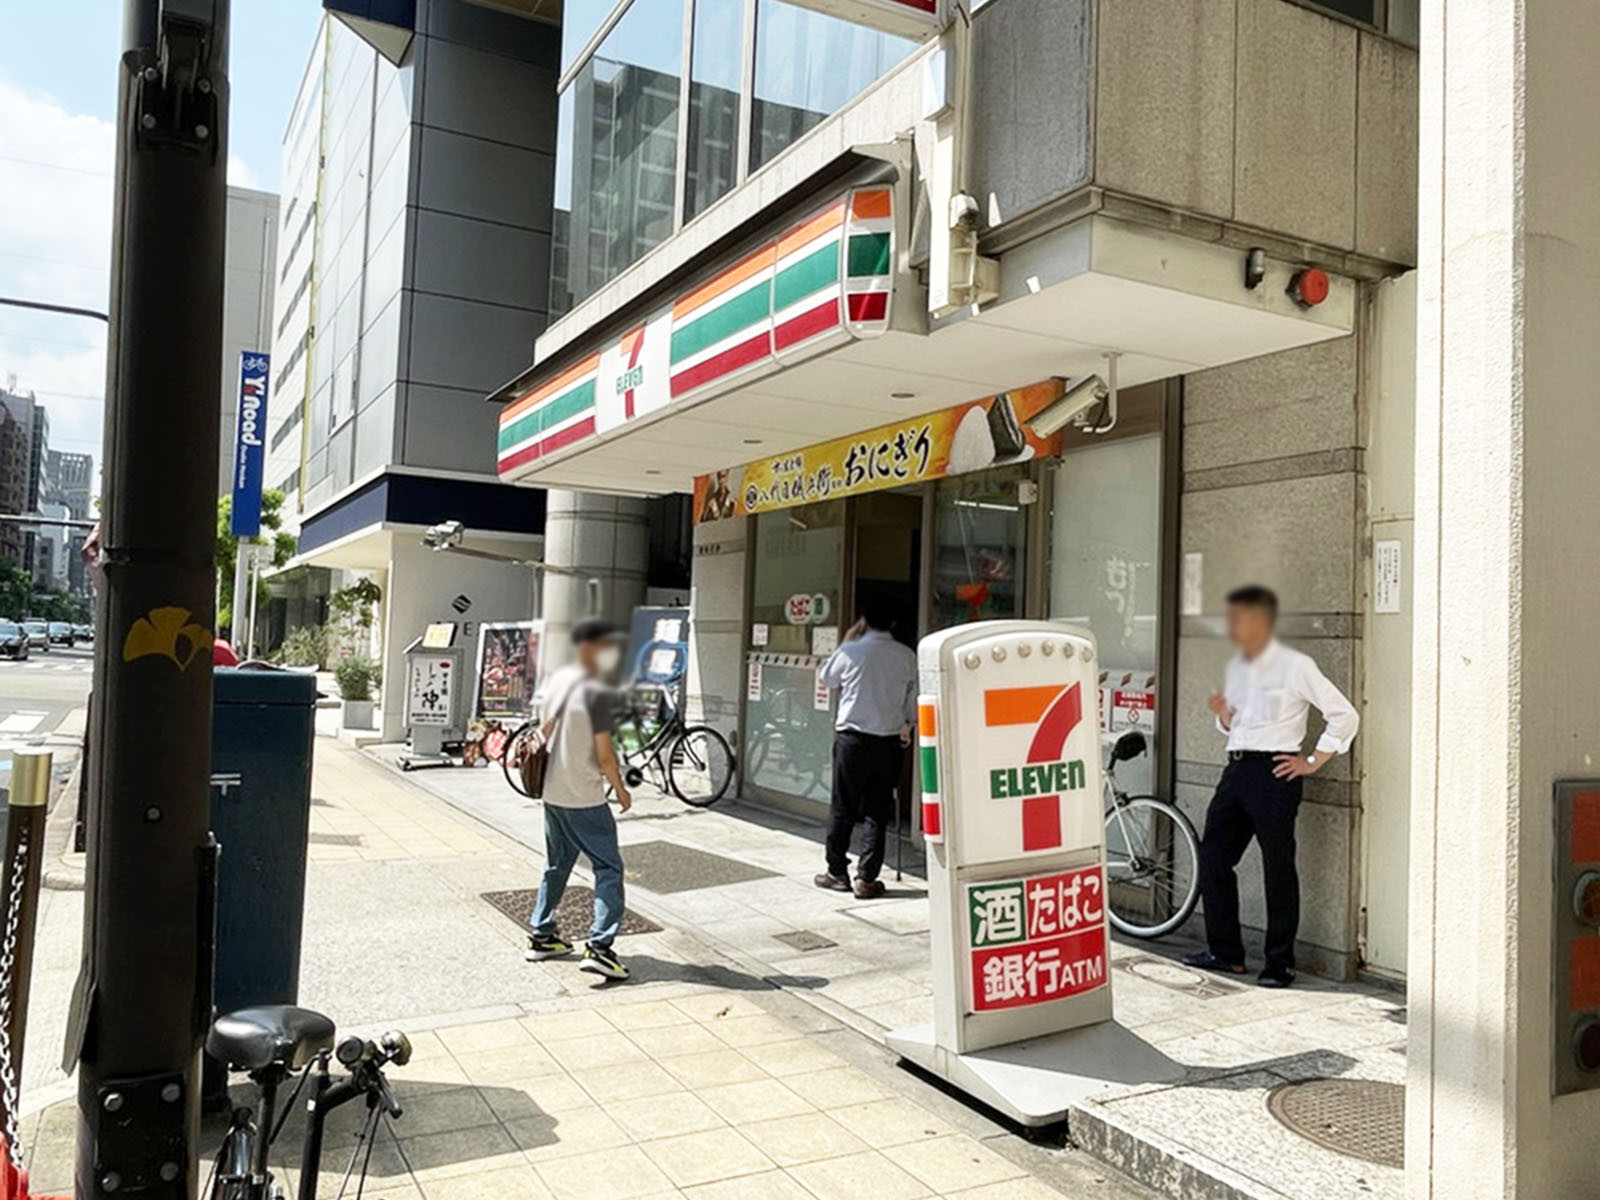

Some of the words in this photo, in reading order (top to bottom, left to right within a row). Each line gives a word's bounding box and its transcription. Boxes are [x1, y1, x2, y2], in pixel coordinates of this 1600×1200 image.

[984, 681, 1082, 851] 7
[973, 886, 1022, 945] 酒
[1029, 874, 1102, 935] たばこ
